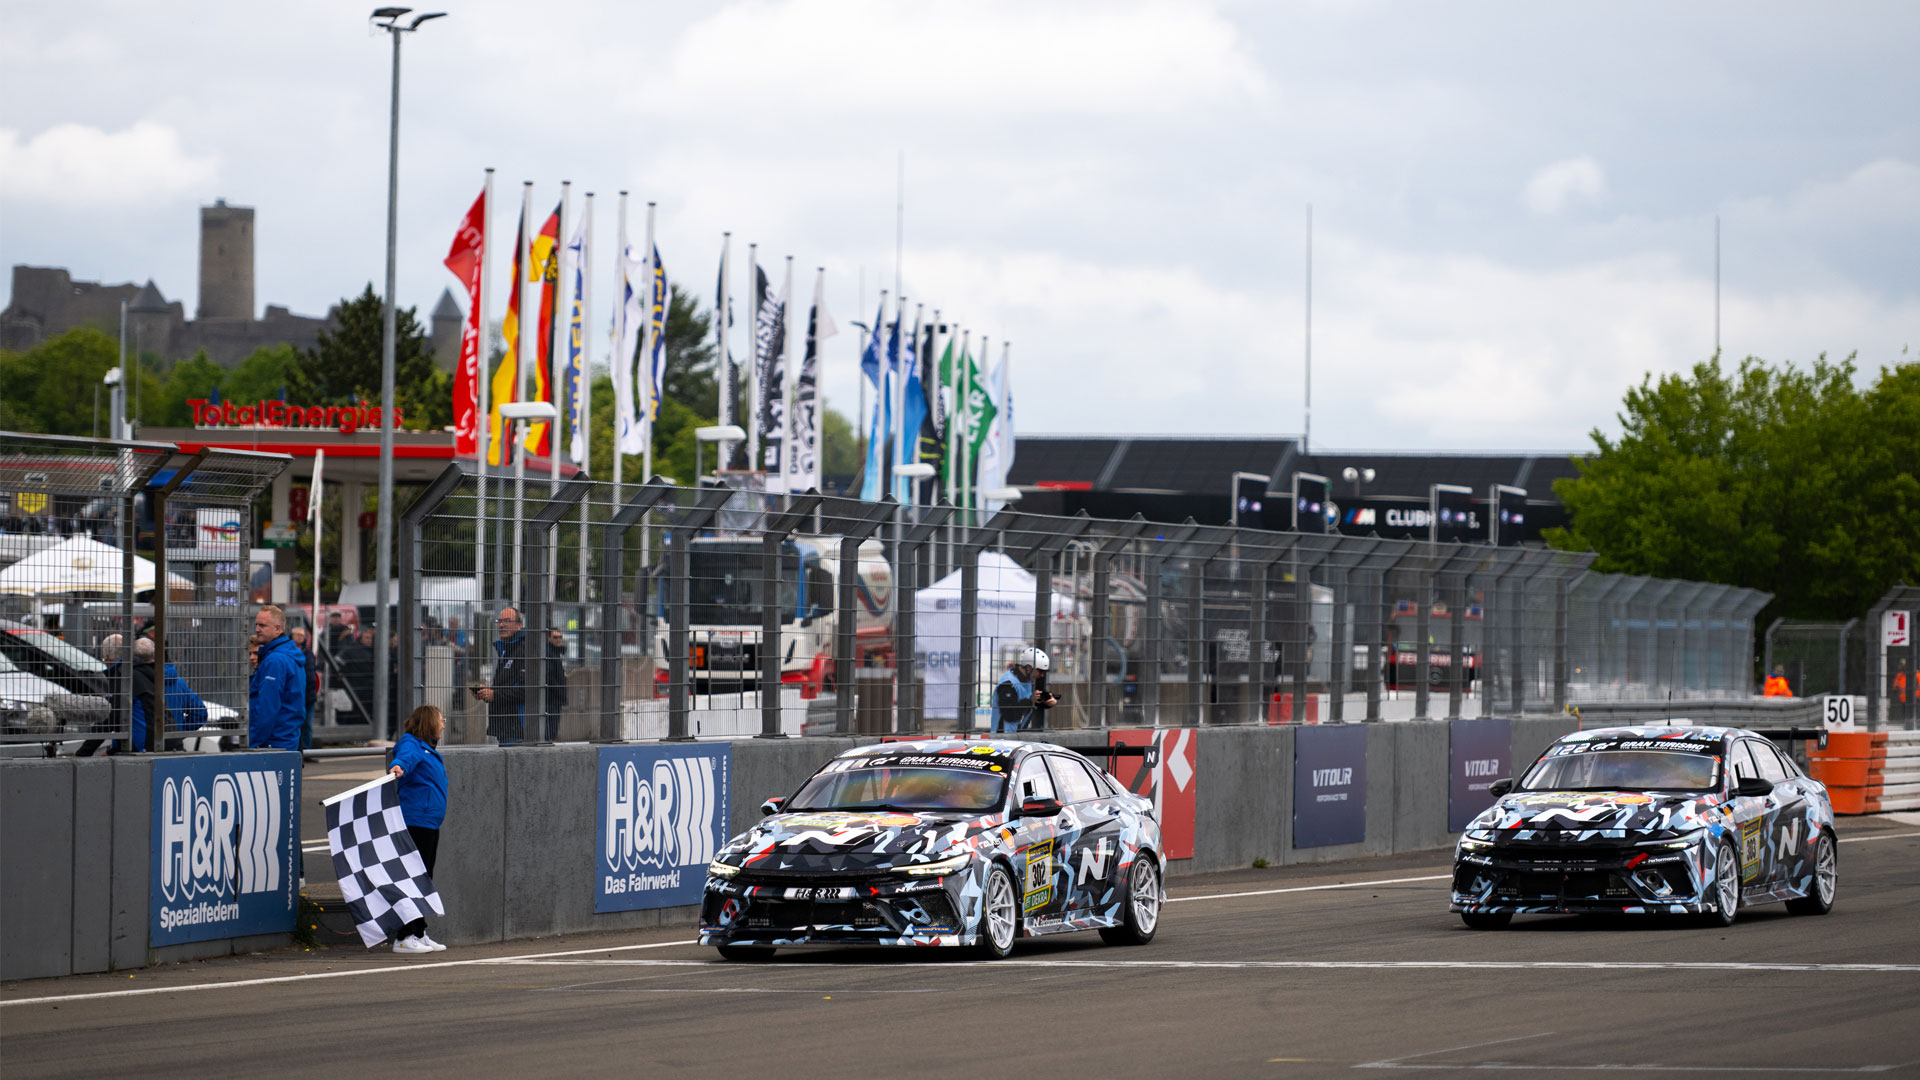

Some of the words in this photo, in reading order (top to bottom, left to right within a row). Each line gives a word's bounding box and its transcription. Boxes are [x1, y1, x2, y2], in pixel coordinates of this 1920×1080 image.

[186, 398, 404, 434] TotalEnergies
[1828, 698, 1849, 723] 50
[1655, 741, 1706, 750] TURISMO
[937, 757, 989, 767] TURISMO
[606, 759, 680, 873] H&R
[720, 755, 728, 849] w.h-r.com
[161, 774, 241, 902] H&R
[287, 768, 295, 911] www.h-r.com
[605, 875, 626, 894] Das
[628, 870, 680, 893] Fahrwerk!
[1032, 862, 1047, 888] 302
[1031, 891, 1048, 907] DEKRA
[160, 902, 240, 932] Spezialfedern
